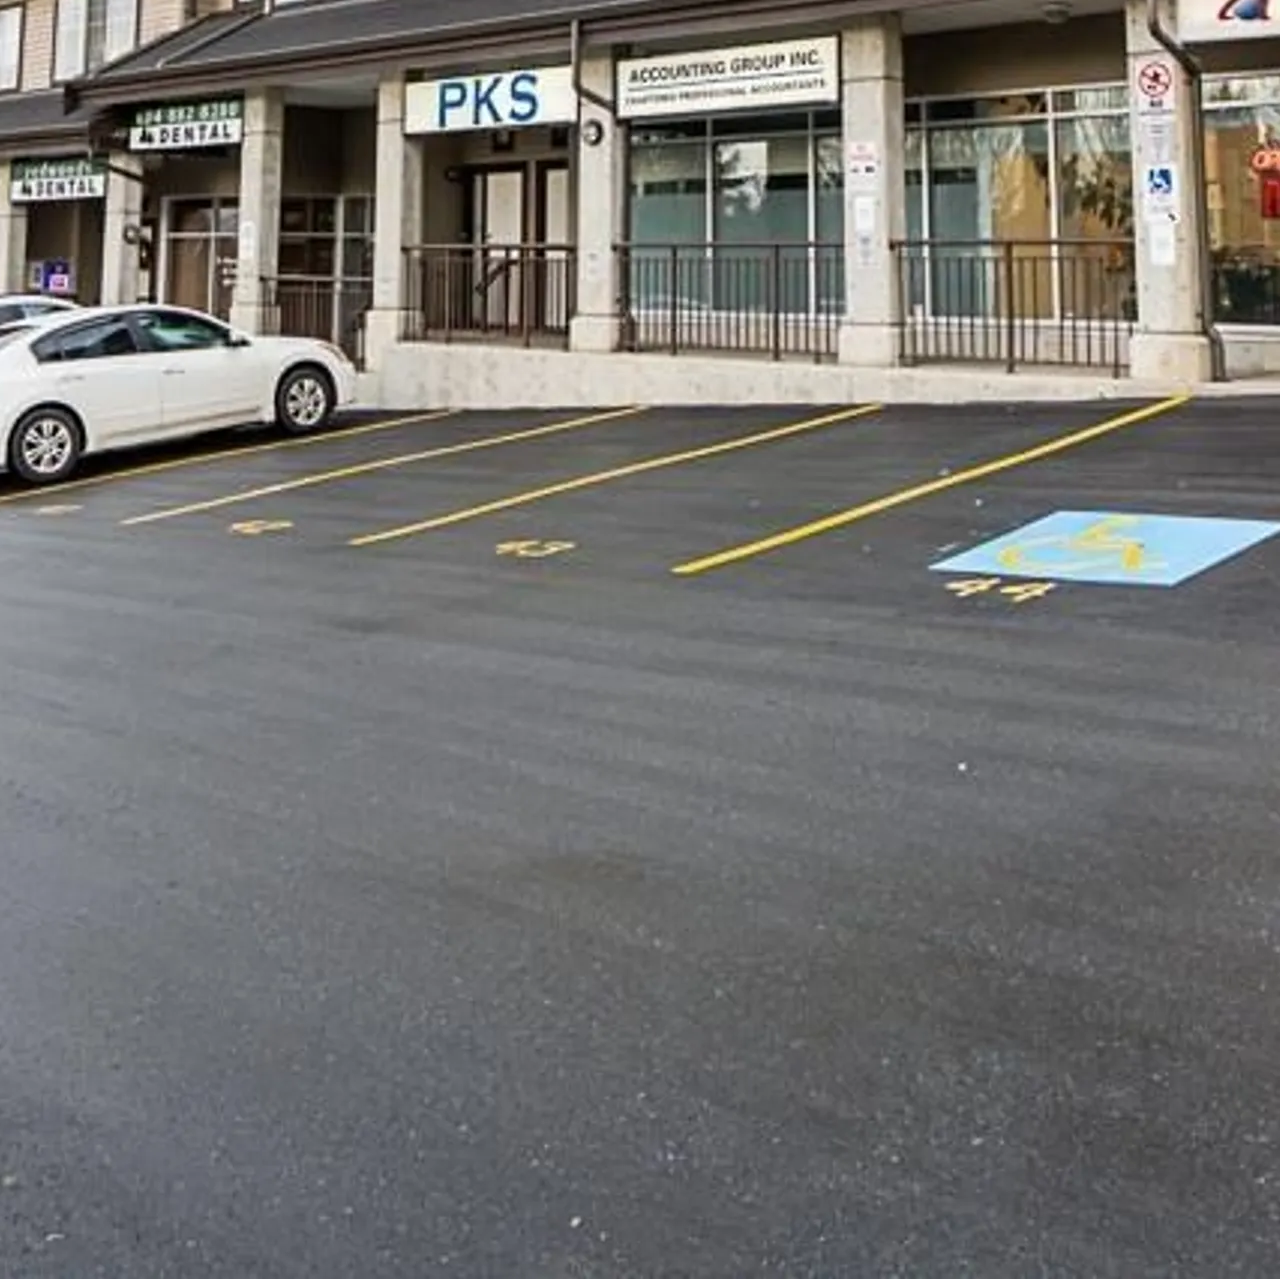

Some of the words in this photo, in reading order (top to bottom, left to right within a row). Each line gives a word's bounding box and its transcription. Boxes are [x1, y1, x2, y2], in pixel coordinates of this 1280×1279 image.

[628, 60, 726, 84] ACCOUNTING
[730, 53, 786, 74] GROUP
[438, 72, 539, 128] PKS
[160, 123, 232, 143] DENTAL
[36, 178, 97, 197] DENTAL
